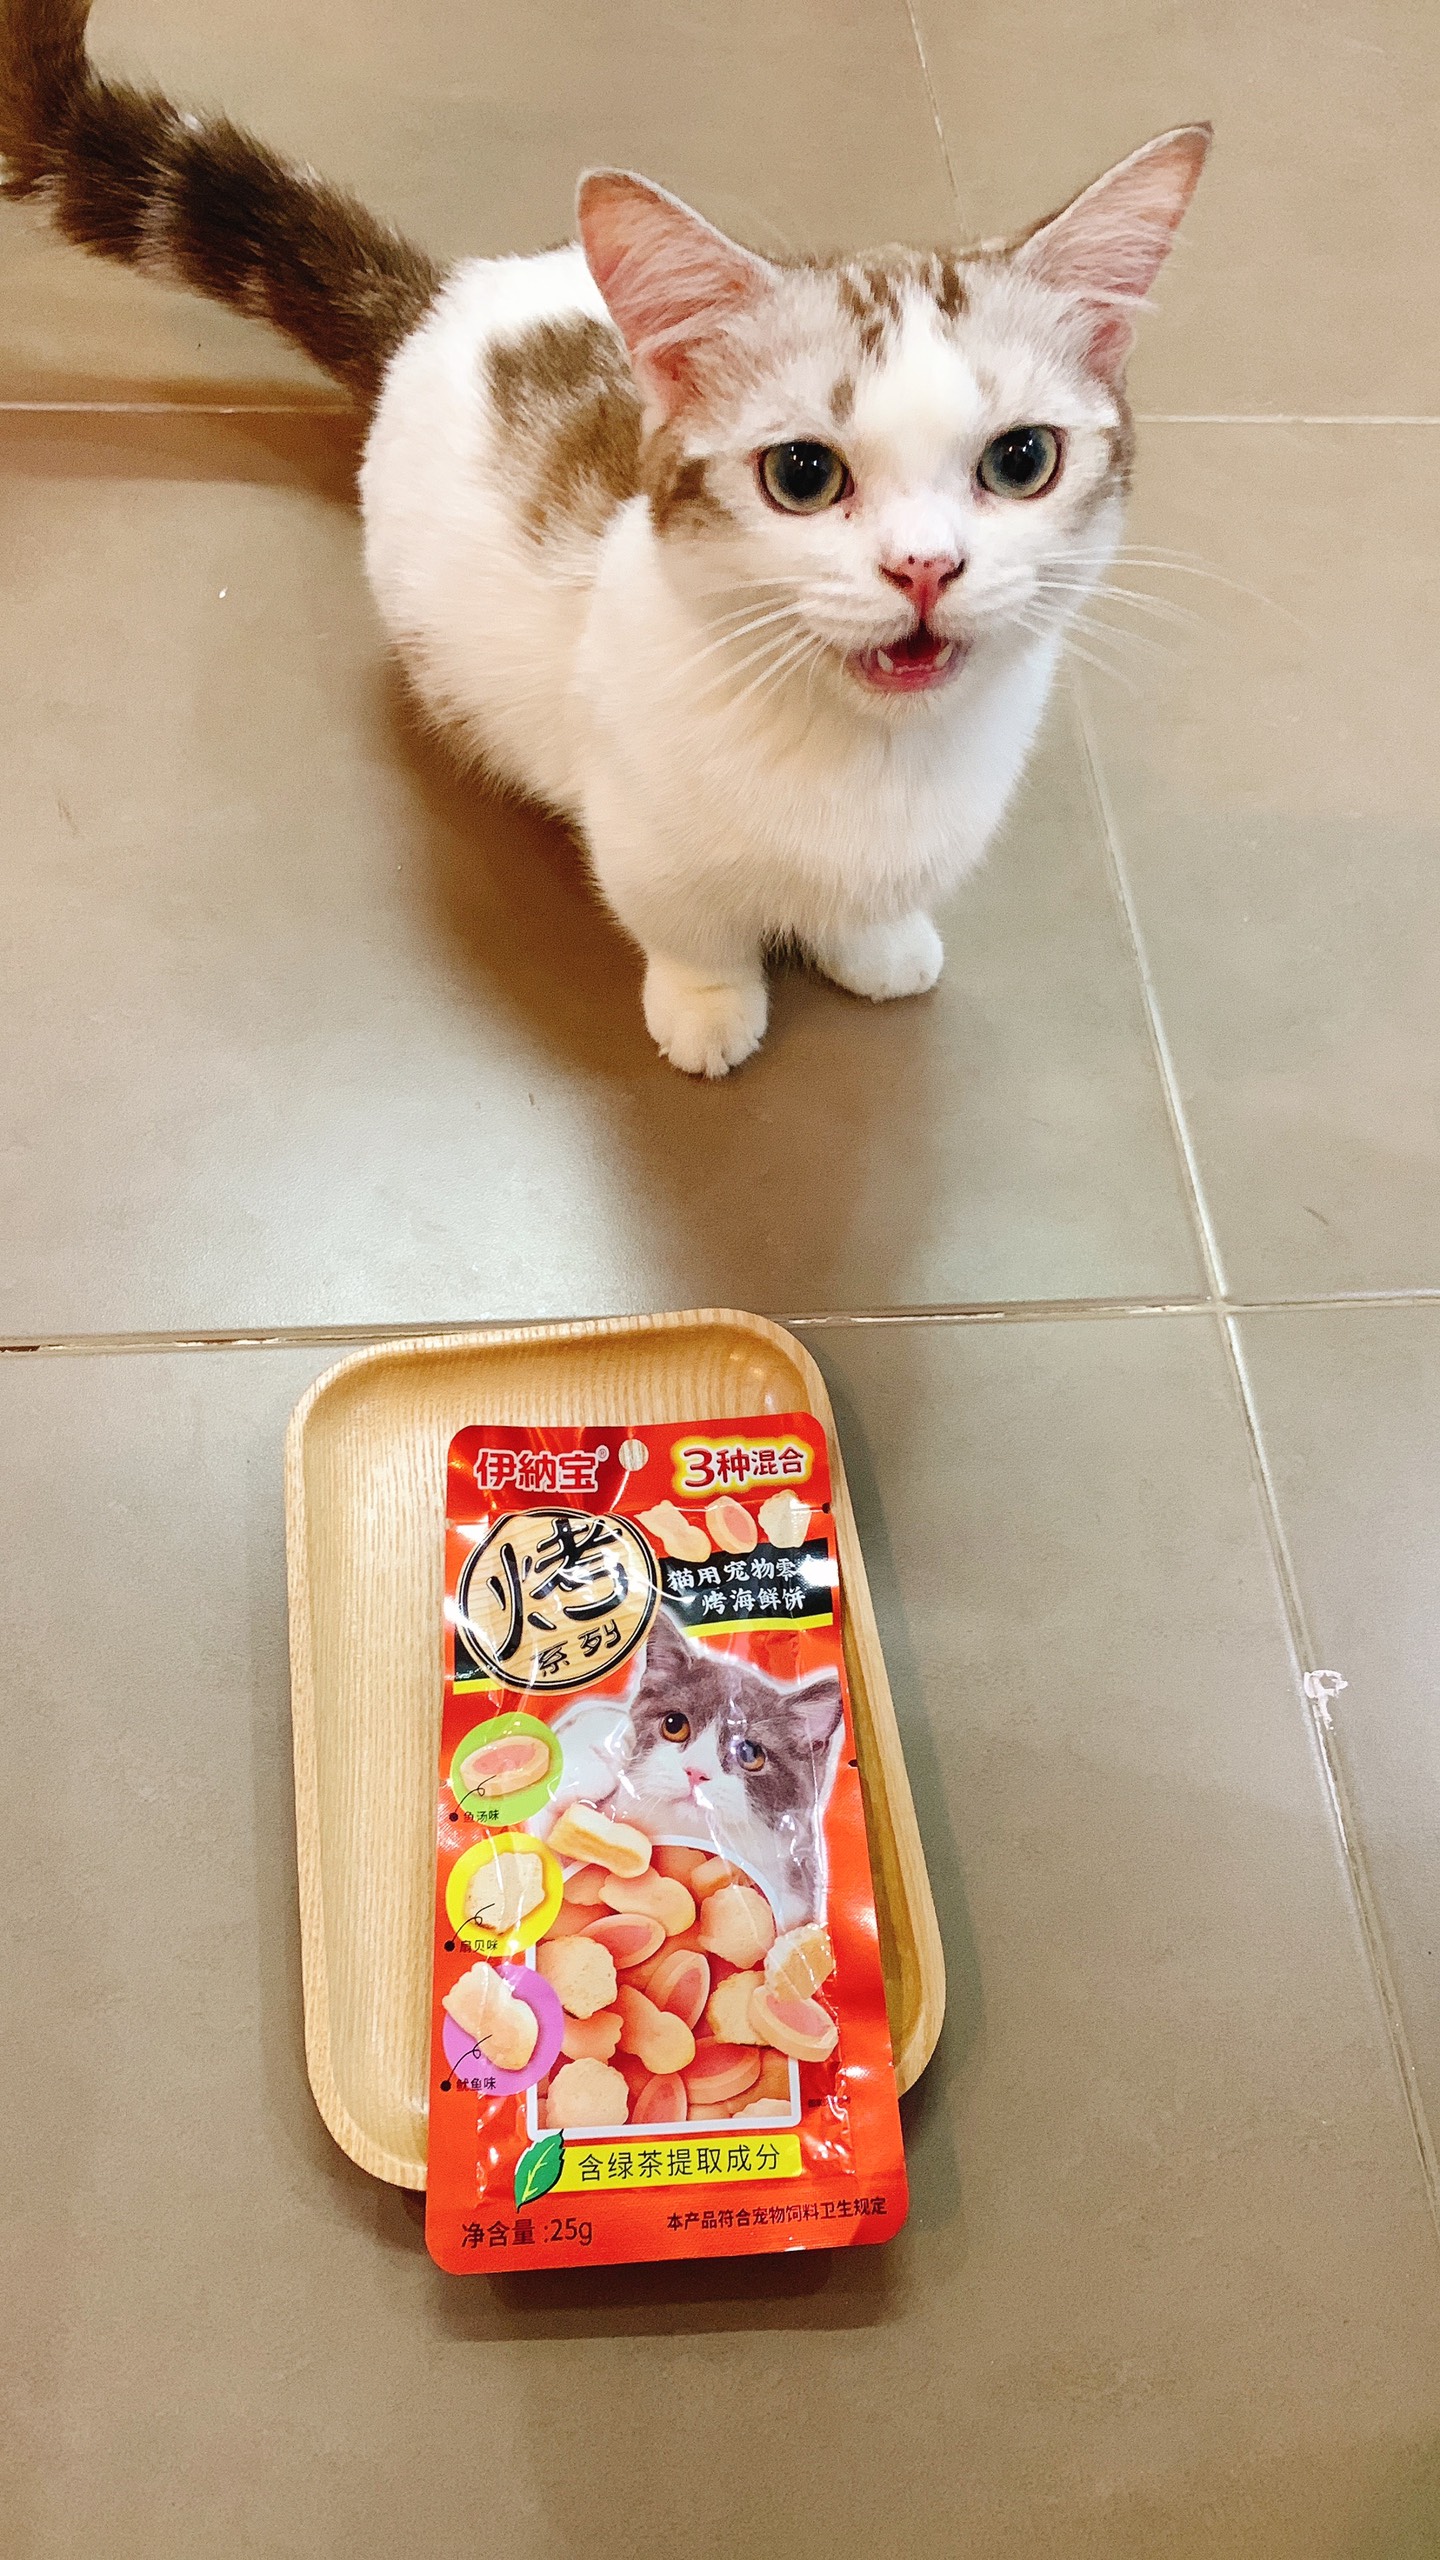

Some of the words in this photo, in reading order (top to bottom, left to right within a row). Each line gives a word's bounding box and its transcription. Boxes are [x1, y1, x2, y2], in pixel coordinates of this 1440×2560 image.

[683, 1446, 804, 1487] 3种混合
[485, 1519, 630, 1662] 烤
[667, 1555, 820, 1592] 猫用宠物零
[701, 1586, 806, 1617] 烤海鲜饼
[532, 1620, 623, 1677] 系列
[463, 1809, 500, 1823] 鱼汤味
[456, 2076, 497, 2092] 鱿鱼味
[577, 2144, 781, 2182] 含绿茶提取成分
[666, 2197, 888, 2232] 本产品符合宠物饲料卫生规定
